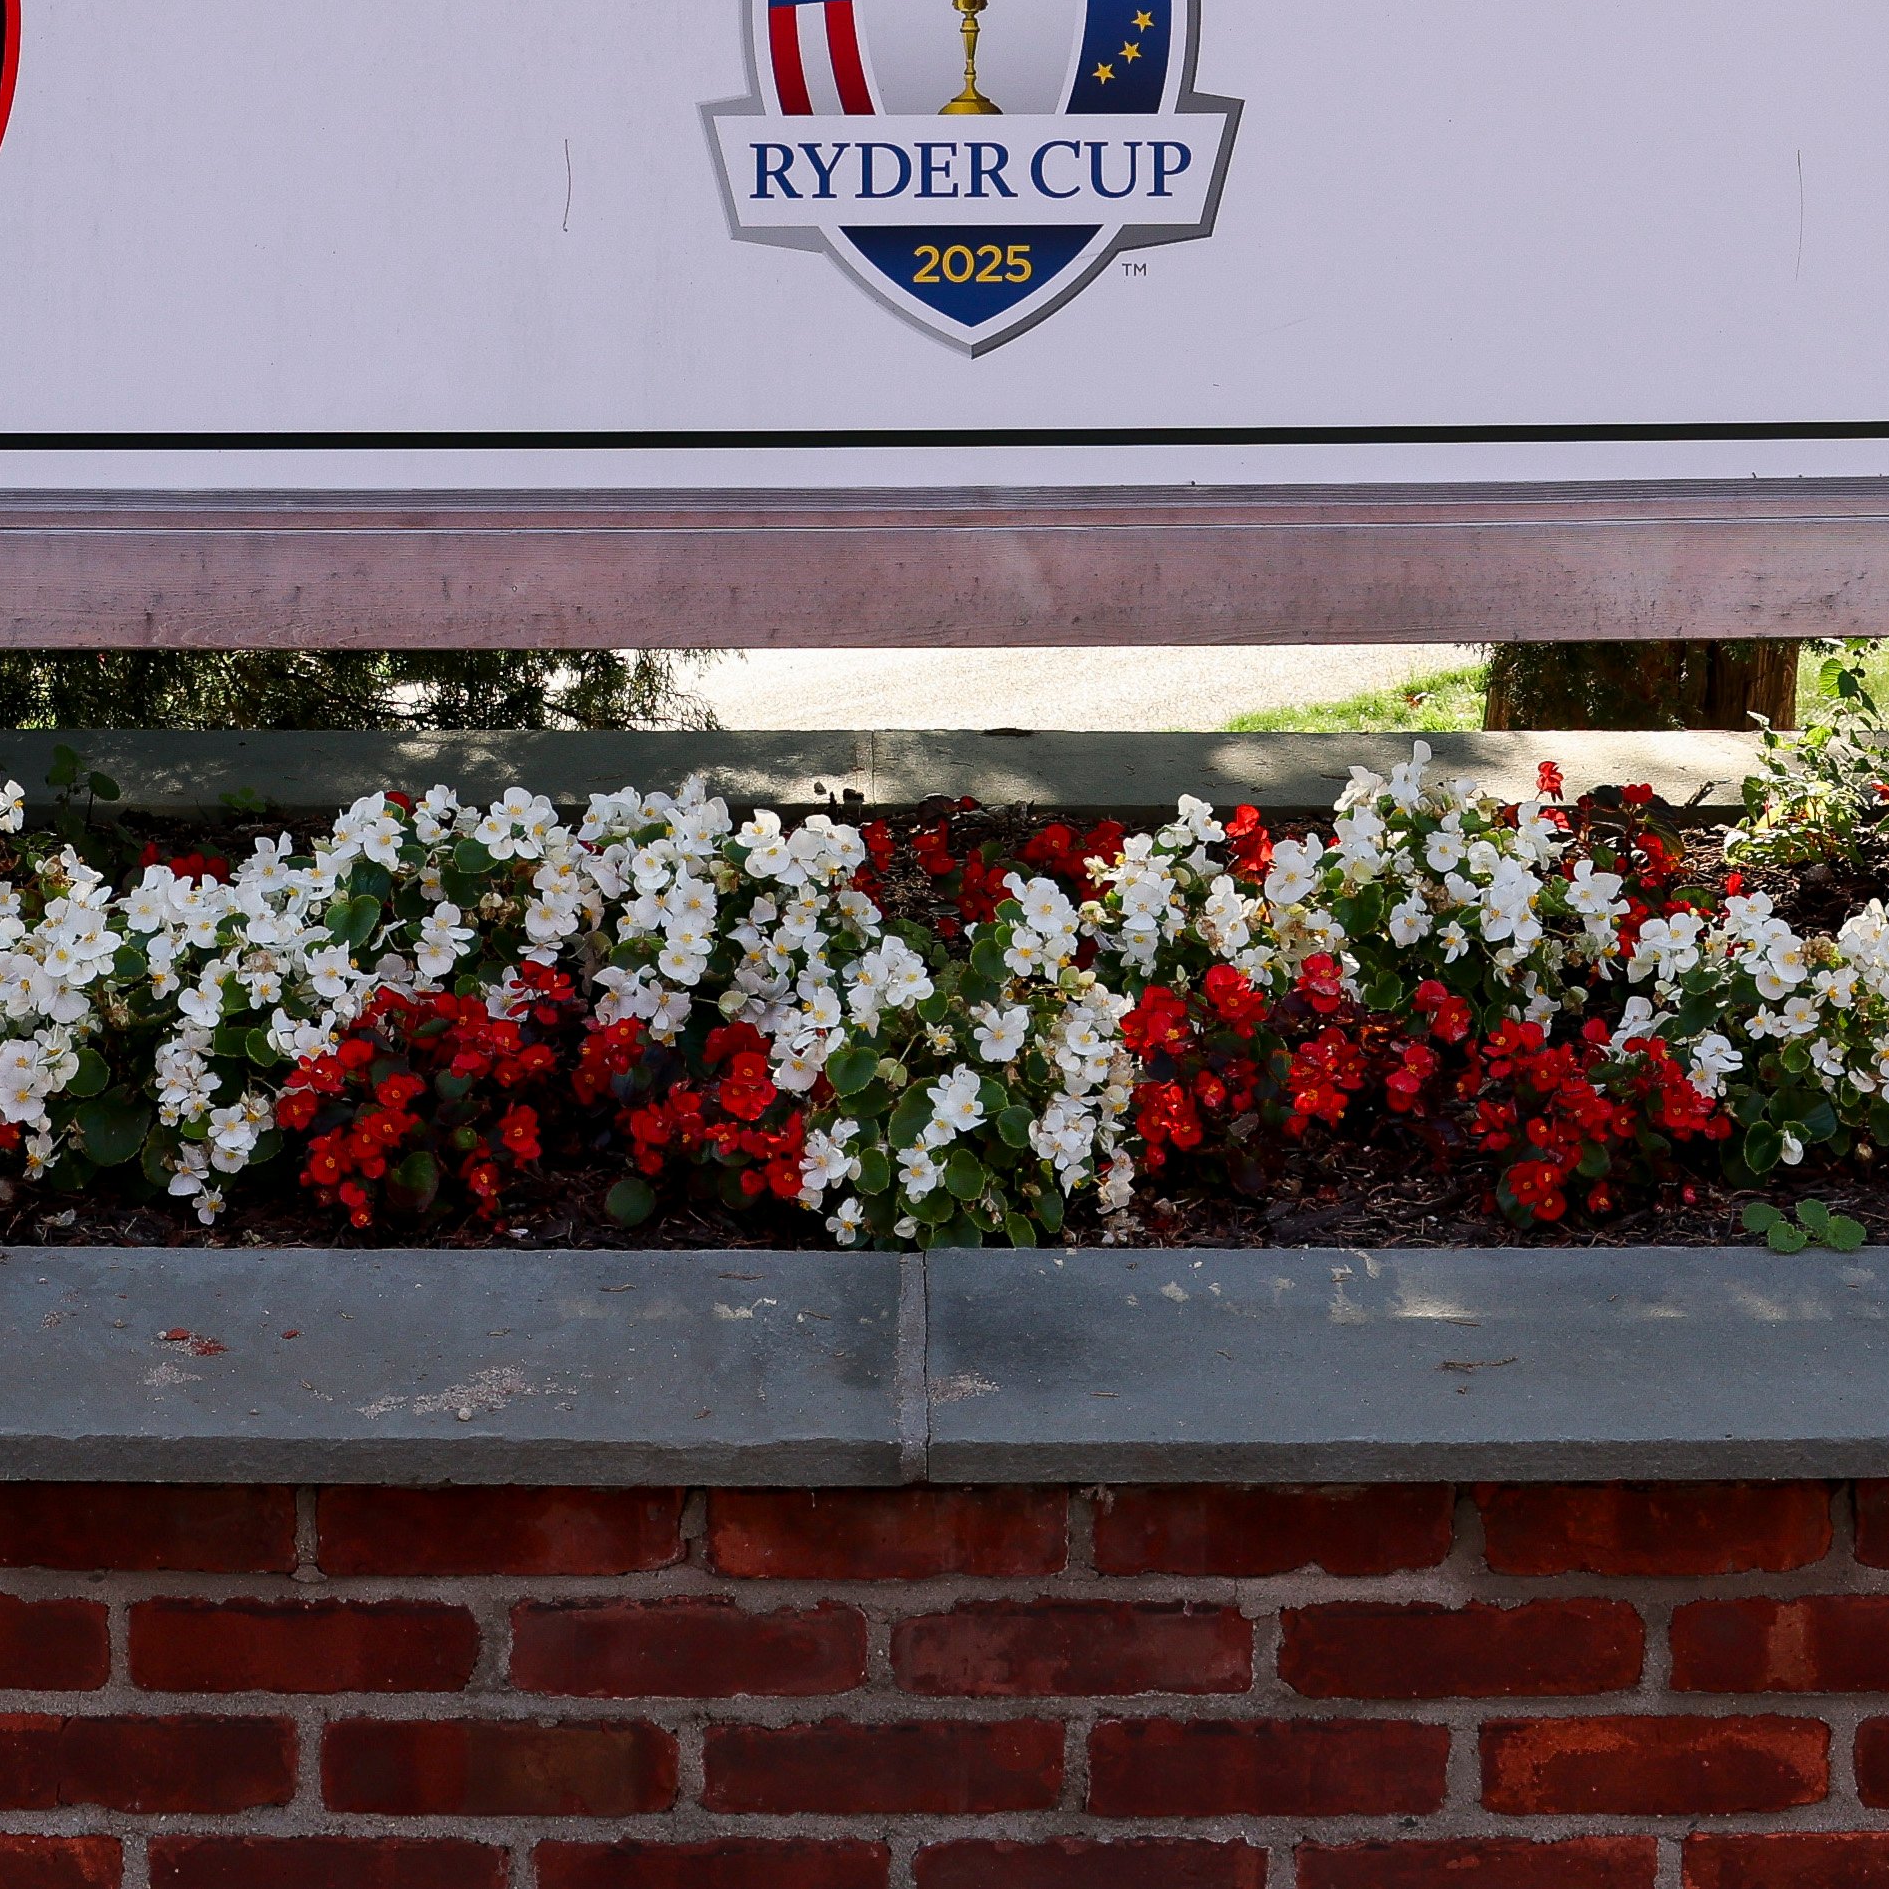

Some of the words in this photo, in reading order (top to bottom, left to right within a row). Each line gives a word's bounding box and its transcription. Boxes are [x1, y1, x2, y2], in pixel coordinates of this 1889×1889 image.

[749, 142, 1018, 198] RYDER
[1030, 140, 1192, 199] CUP
[912, 245, 1032, 283] 2025
